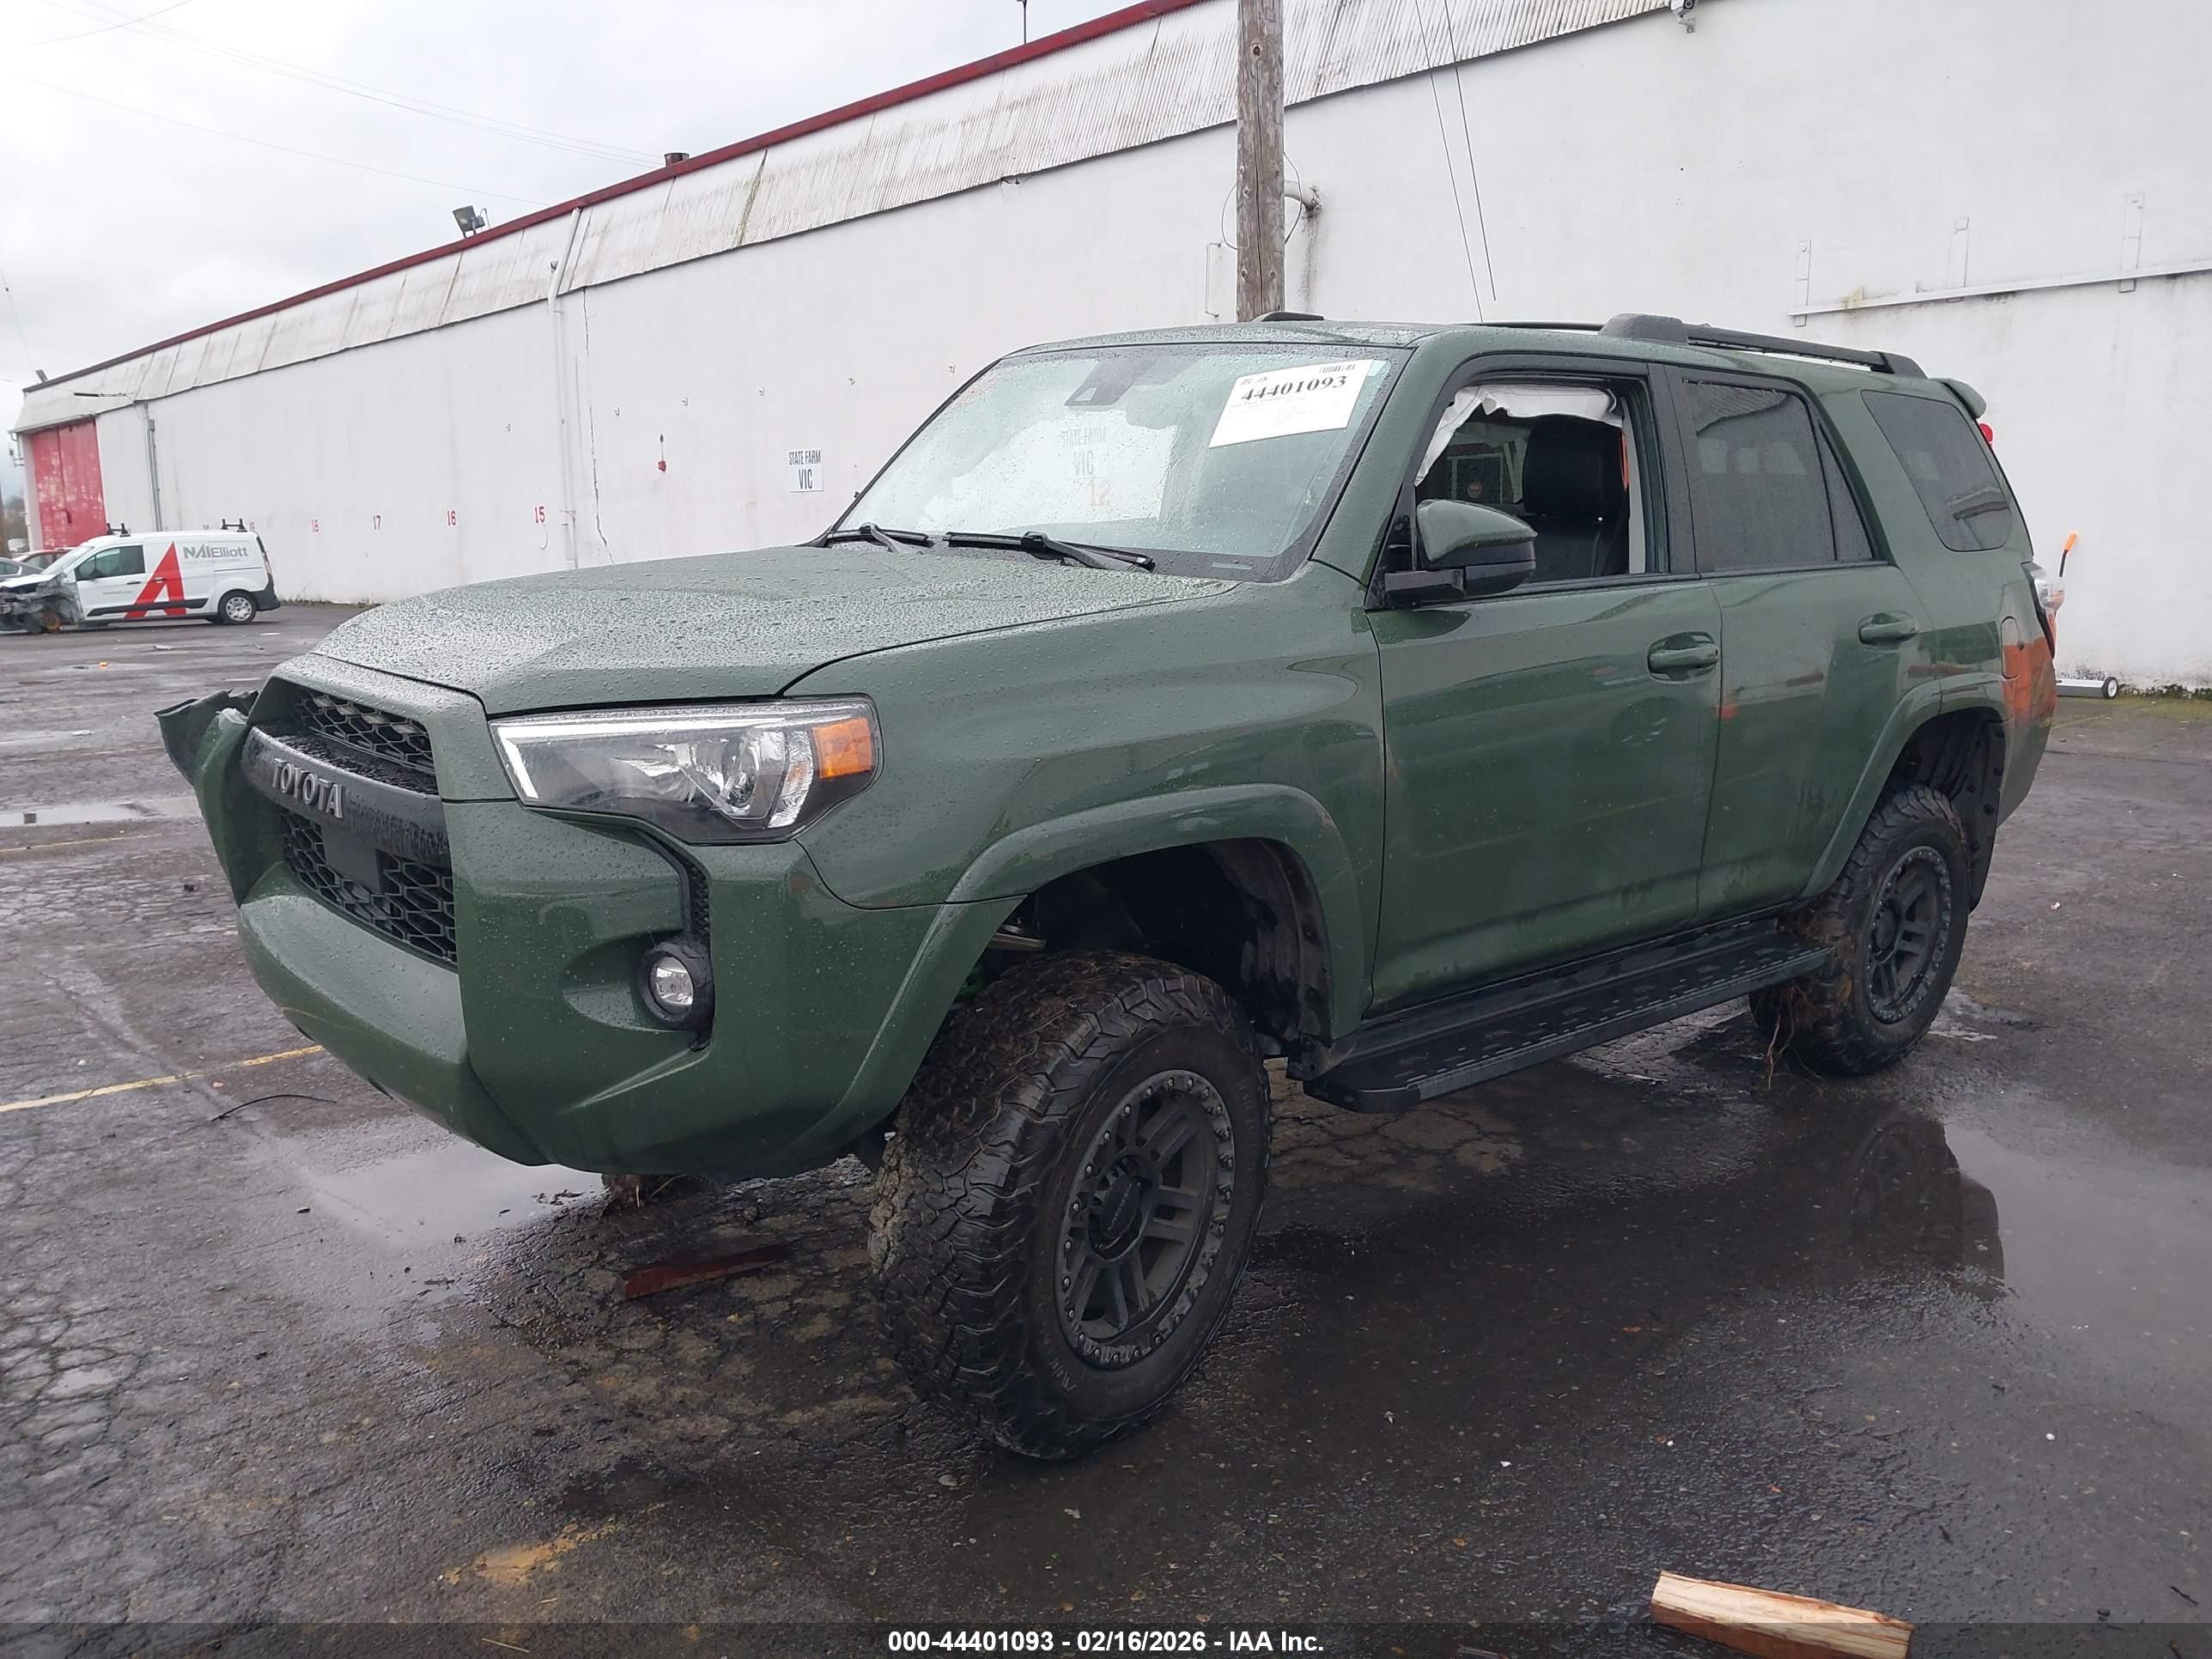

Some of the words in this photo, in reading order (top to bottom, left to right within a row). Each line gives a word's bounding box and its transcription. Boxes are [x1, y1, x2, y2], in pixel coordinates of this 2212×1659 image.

[1241, 375, 1346, 401] 44401093
[788, 451, 805, 465] STATE
[805, 449, 821, 465] FARM
[1073, 450, 1094, 476] VIC
[798, 468, 812, 489] VIC
[373, 514, 381, 530] 17
[447, 510, 456, 526] 16
[534, 506, 545, 524] 15
[272, 757, 343, 818] TOYOTA
